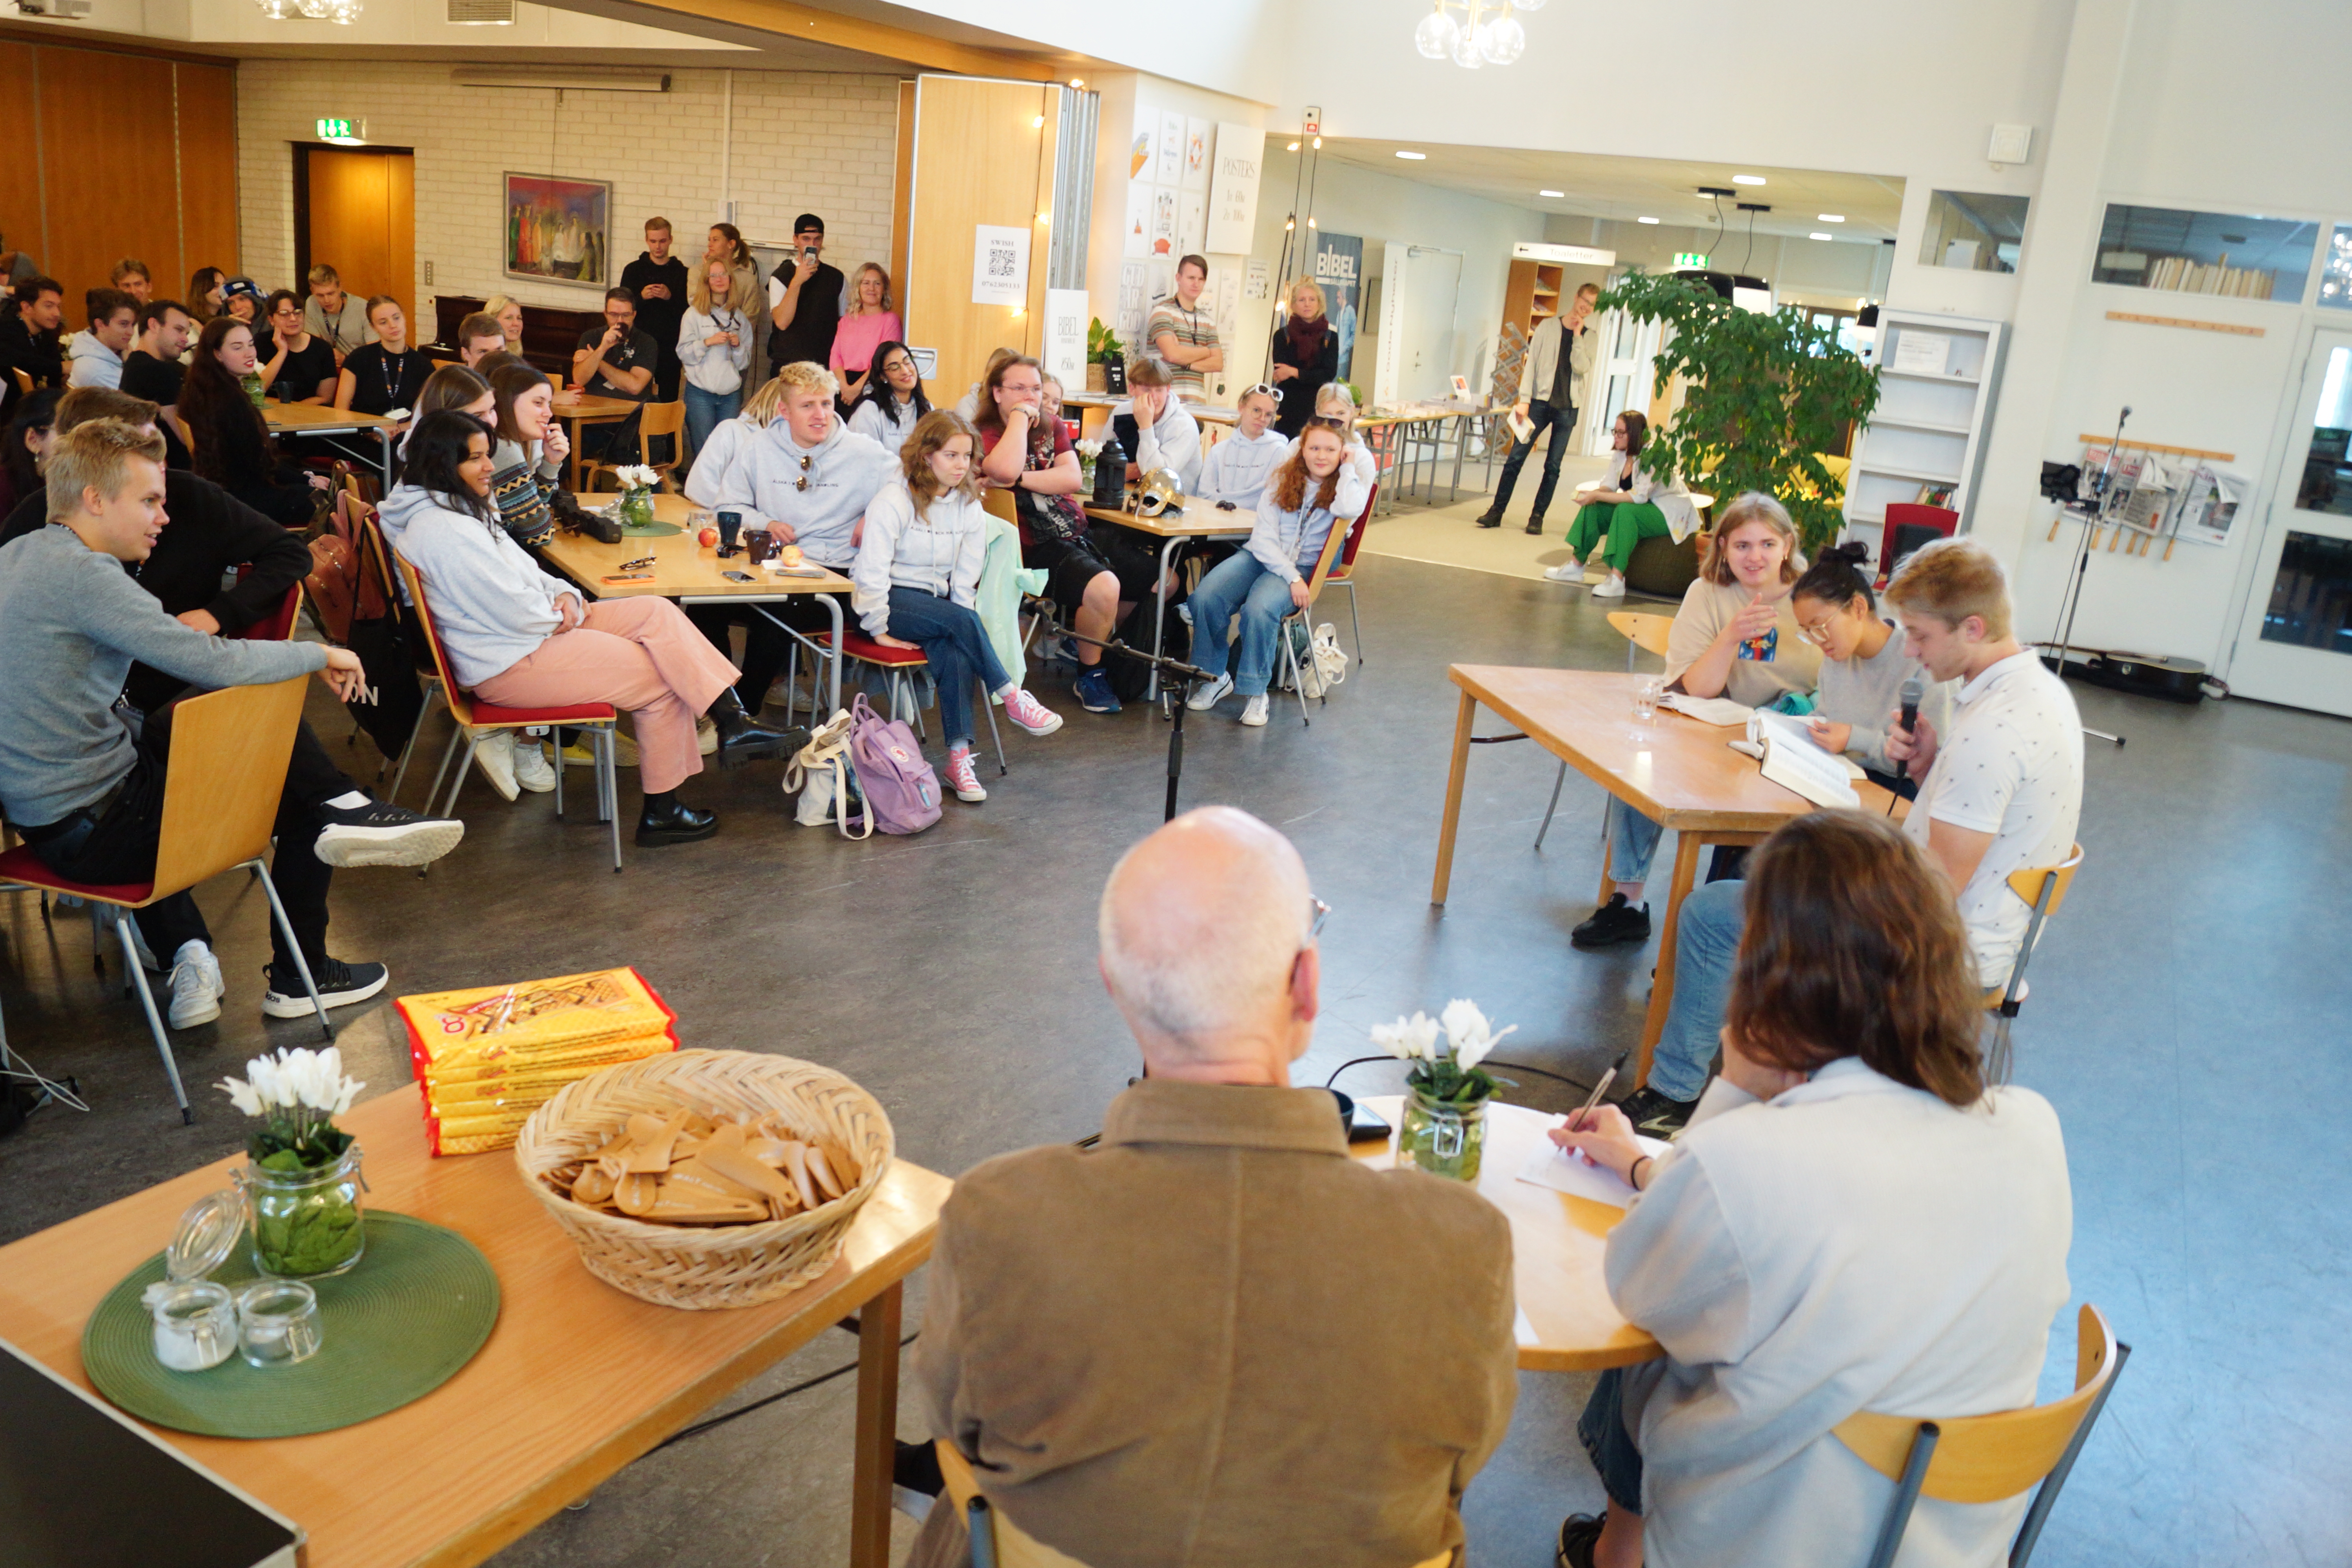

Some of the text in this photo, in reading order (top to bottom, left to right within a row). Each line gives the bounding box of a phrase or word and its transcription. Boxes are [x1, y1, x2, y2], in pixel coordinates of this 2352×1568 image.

[1223, 157, 1256, 179] POSTERS
[1316, 244, 1357, 279] BIBEL
[1550, 248, 1594, 260] Toaletter
[982, 281, 1020, 289] 0762305133
[1058, 316, 1079, 336] BIBEL
